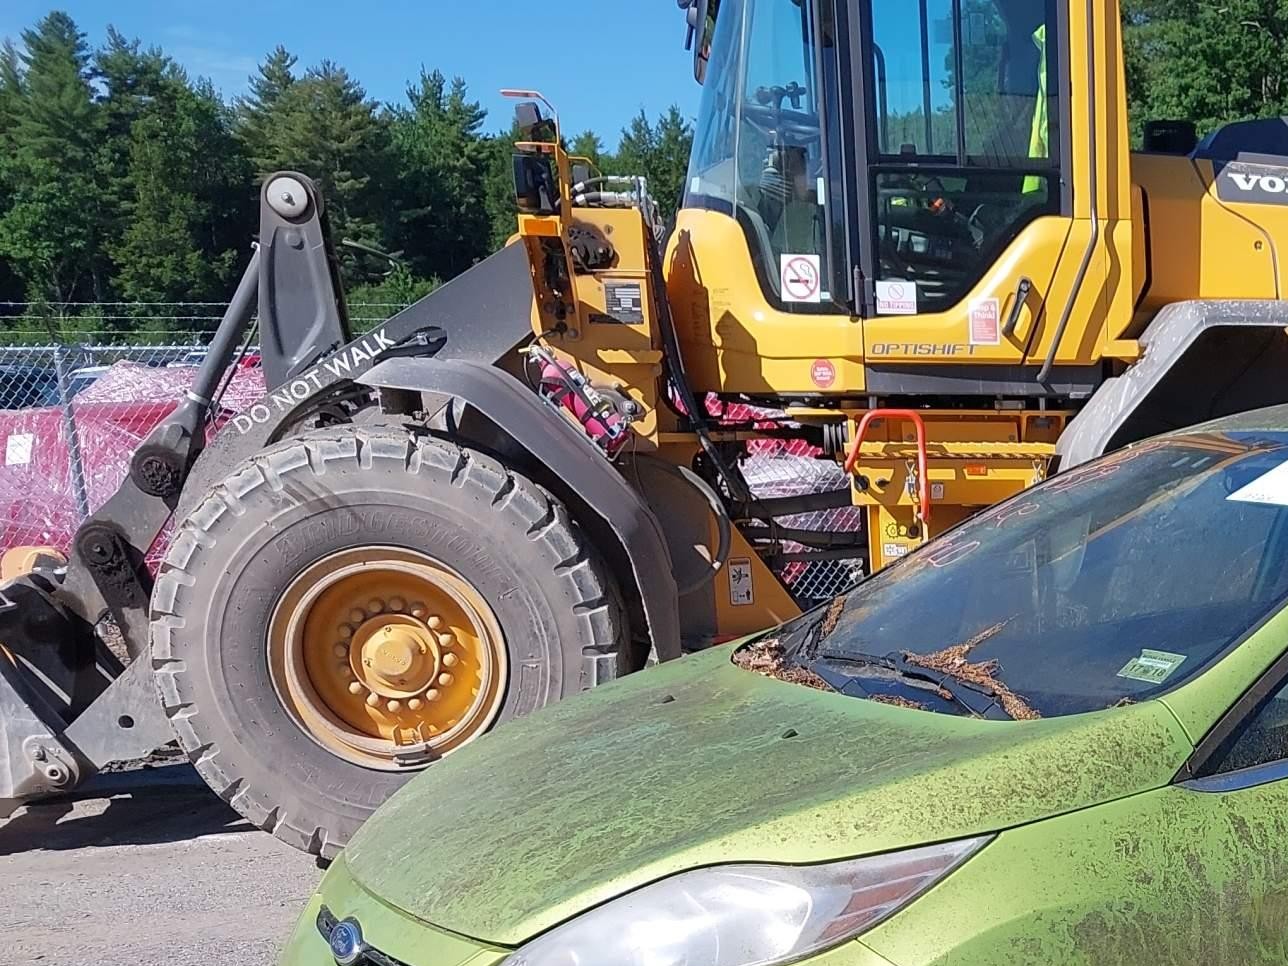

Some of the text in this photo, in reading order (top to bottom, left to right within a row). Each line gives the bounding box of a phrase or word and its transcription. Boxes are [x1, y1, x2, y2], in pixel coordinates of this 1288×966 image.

[872, 343, 978, 355] OPTISHIFT
[232, 328, 396, 434] DO NOT WALK
